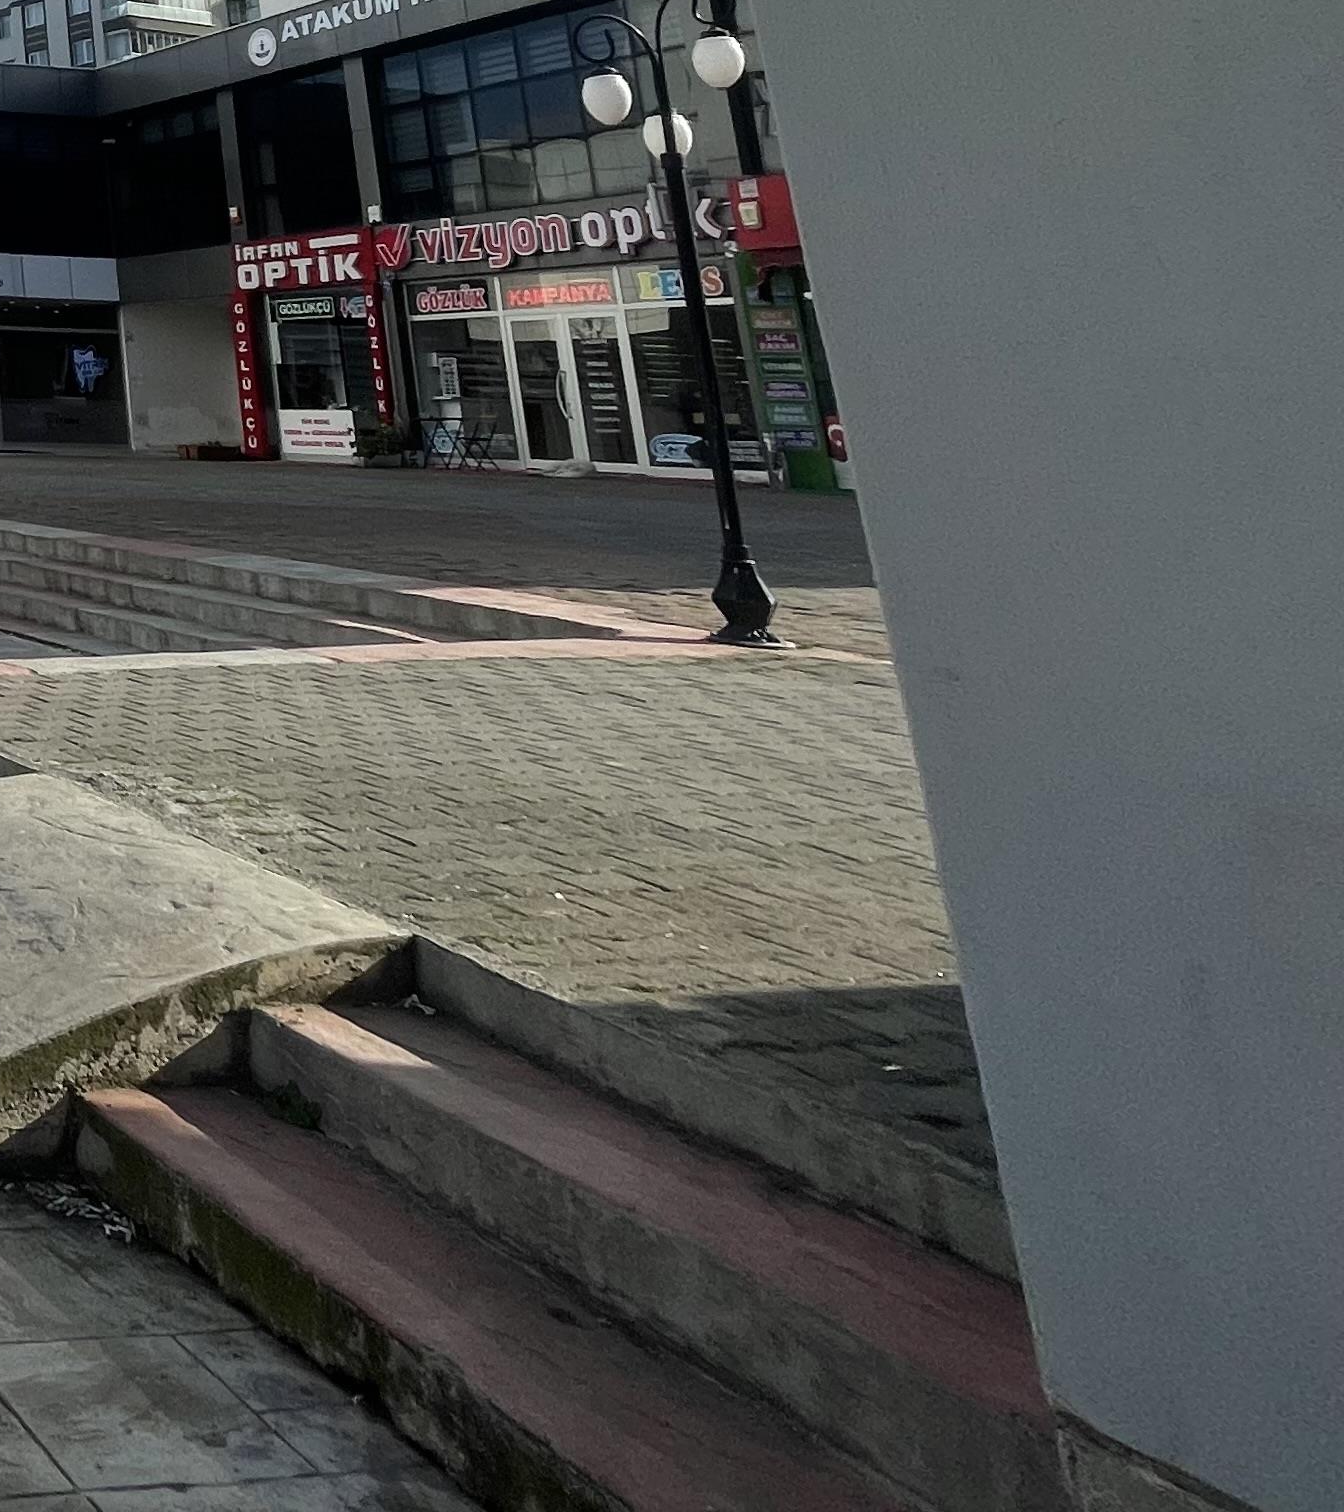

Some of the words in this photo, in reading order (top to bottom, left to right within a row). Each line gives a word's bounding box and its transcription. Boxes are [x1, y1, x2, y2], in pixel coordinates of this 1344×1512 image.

[416, 213, 570, 268] vizyon
[581, 182, 722, 255] optk
[237, 250, 362, 290] OPTİK
[637, 265, 725, 300] LES
[279, 300, 331, 315] GÖZLÜKÇÜ
[416, 285, 487, 313] GÖZLÜK
[507, 281, 611, 307] KAMPANYA
[234, 303, 257, 449] GÖZLÜKÇÜ
